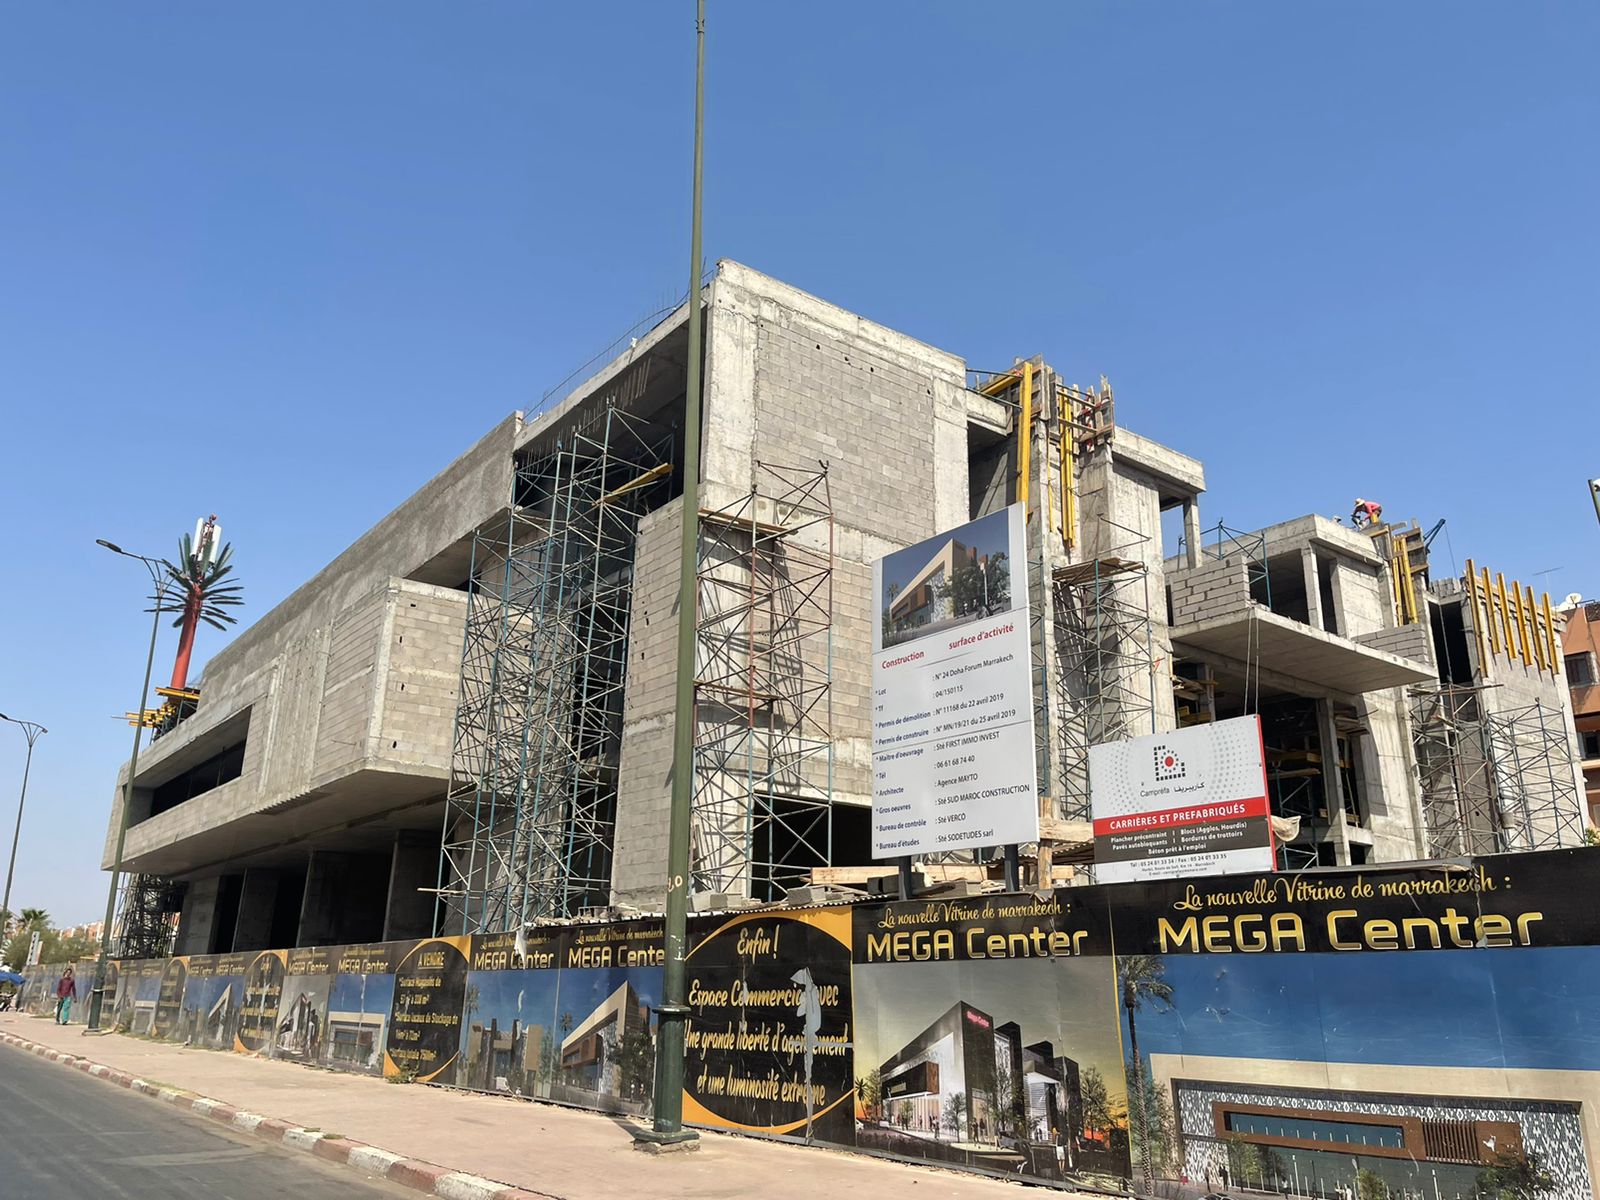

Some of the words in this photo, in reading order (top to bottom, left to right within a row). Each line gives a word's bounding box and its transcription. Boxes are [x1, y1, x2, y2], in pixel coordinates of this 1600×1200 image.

[949, 635, 976, 650] surface
[976, 623, 1014, 641] d'activité
[881, 651, 925, 669] Construction
[878, 688, 886, 696] Lot
[942, 671, 949, 679] 24
[950, 668, 964, 677] Doha
[964, 663, 982, 672] Forum
[983, 653, 1014, 667] Marrakech
[879, 720, 895, 728] Permis
[902, 711, 931, 723] démolition
[943, 703, 959, 713] 11168
[960, 701, 968, 710] du
[968, 700, 976, 708] 22
[976, 696, 989, 706] avril
[989, 693, 1004, 703] 2019
[879, 737, 895, 745] Permis
[896, 734, 902, 742] de
[903, 730, 929, 740] construire
[970, 717, 979, 726] du
[979, 715, 987, 724] 25
[987, 712, 1000, 722] avril
[1001, 709, 1016, 720] 2019
[895, 748, 924, 759] d'oeuvrage
[936, 742, 945, 751] Sté
[946, 739, 960, 749] FIRST
[961, 736, 979, 746] IMMO
[979, 731, 1000, 742] INVEST
[936, 761, 944, 769] 06
[960, 756, 967, 764] 74
[879, 787, 904, 796] Architecte
[937, 778, 958, 788] Agence
[958, 773, 979, 783] MAYTO
[879, 806, 890, 814] Gros
[891, 804, 911, 812] oeuvres
[937, 797, 946, 806] Sté
[947, 795, 960, 804] SUD
[960, 792, 981, 802] MAROC
[981, 784, 1030, 799] CONSTRUCTION
[879, 824, 897, 832] Bureau
[937, 816, 946, 824] Sté
[947, 812, 966, 823] VERCO
[1110, 815, 1157, 830] CARRIÈRES
[1160, 814, 1171, 823] ET
[1173, 802, 1246, 822] PREFABRIQUÉS
[879, 842, 897, 850] Bureau
[938, 835, 947, 843] Sté
[947, 830, 982, 842] SODETUDES
[982, 829, 994, 837] sarl
[1128, 839, 1168, 849] autobloquants
[1134, 831, 1168, 842] précontraint
[1182, 843, 1206, 852] l'emploi
[1174, 884, 1203, 910] La
[1205, 879, 1277, 906] nouvelle
[1274, 874, 1346, 903] Vitrine
[1351, 874, 1374, 898] de
[1378, 865, 1497, 897] marrakech
[878, 908, 896, 928] La
[897, 903, 940, 925] nouvelle
[938, 900, 980, 922] Vitrine
[982, 901, 995, 920] de
[997, 895, 1063, 918] marrakech
[867, 929, 954, 962] MEGA
[966, 926, 1088, 959] Center
[1158, 912, 1306, 954] MEGA
[1327, 908, 1544, 951] Center
[568, 946, 612, 968] MEGA
[618, 945, 665, 967] Cente
[737, 927, 771, 965] Enfin
[337, 958, 360, 974] MEGA
[362, 959, 389, 974] Center
[474, 951, 507, 970] MEGA
[688, 979, 728, 1016] Espace
[731, 979, 803, 1007] Commercia
[817, 985, 839, 1006] vec
[700, 1021, 735, 1060] grande
[736, 1021, 771, 1052] liberté
[772, 1021, 848, 1065] d'agenement
[696, 1064, 708, 1094] et
[707, 1075, 726, 1096] une
[726, 1065, 780, 1101] luminosité
